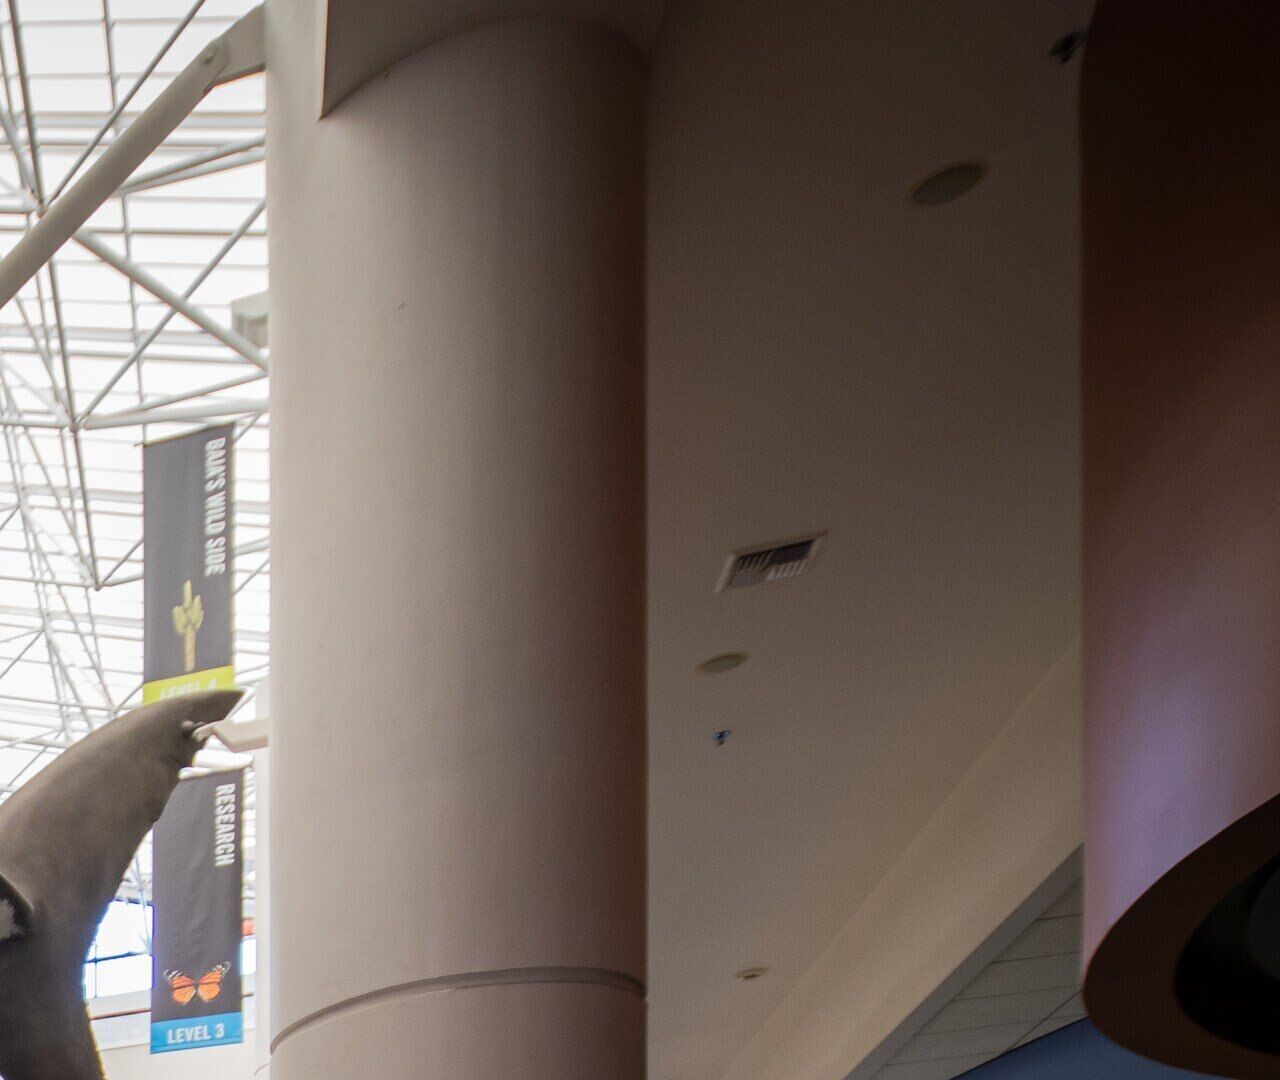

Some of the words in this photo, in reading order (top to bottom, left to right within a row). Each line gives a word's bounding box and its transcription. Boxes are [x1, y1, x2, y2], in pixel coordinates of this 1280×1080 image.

[205, 491, 226, 536] WILD
[205, 537, 226, 577] SIDE
[214, 783, 235, 867] RESEARCH
[167, 1026, 211, 1044] LEVEL
[216, 1023, 225, 1039] 3
